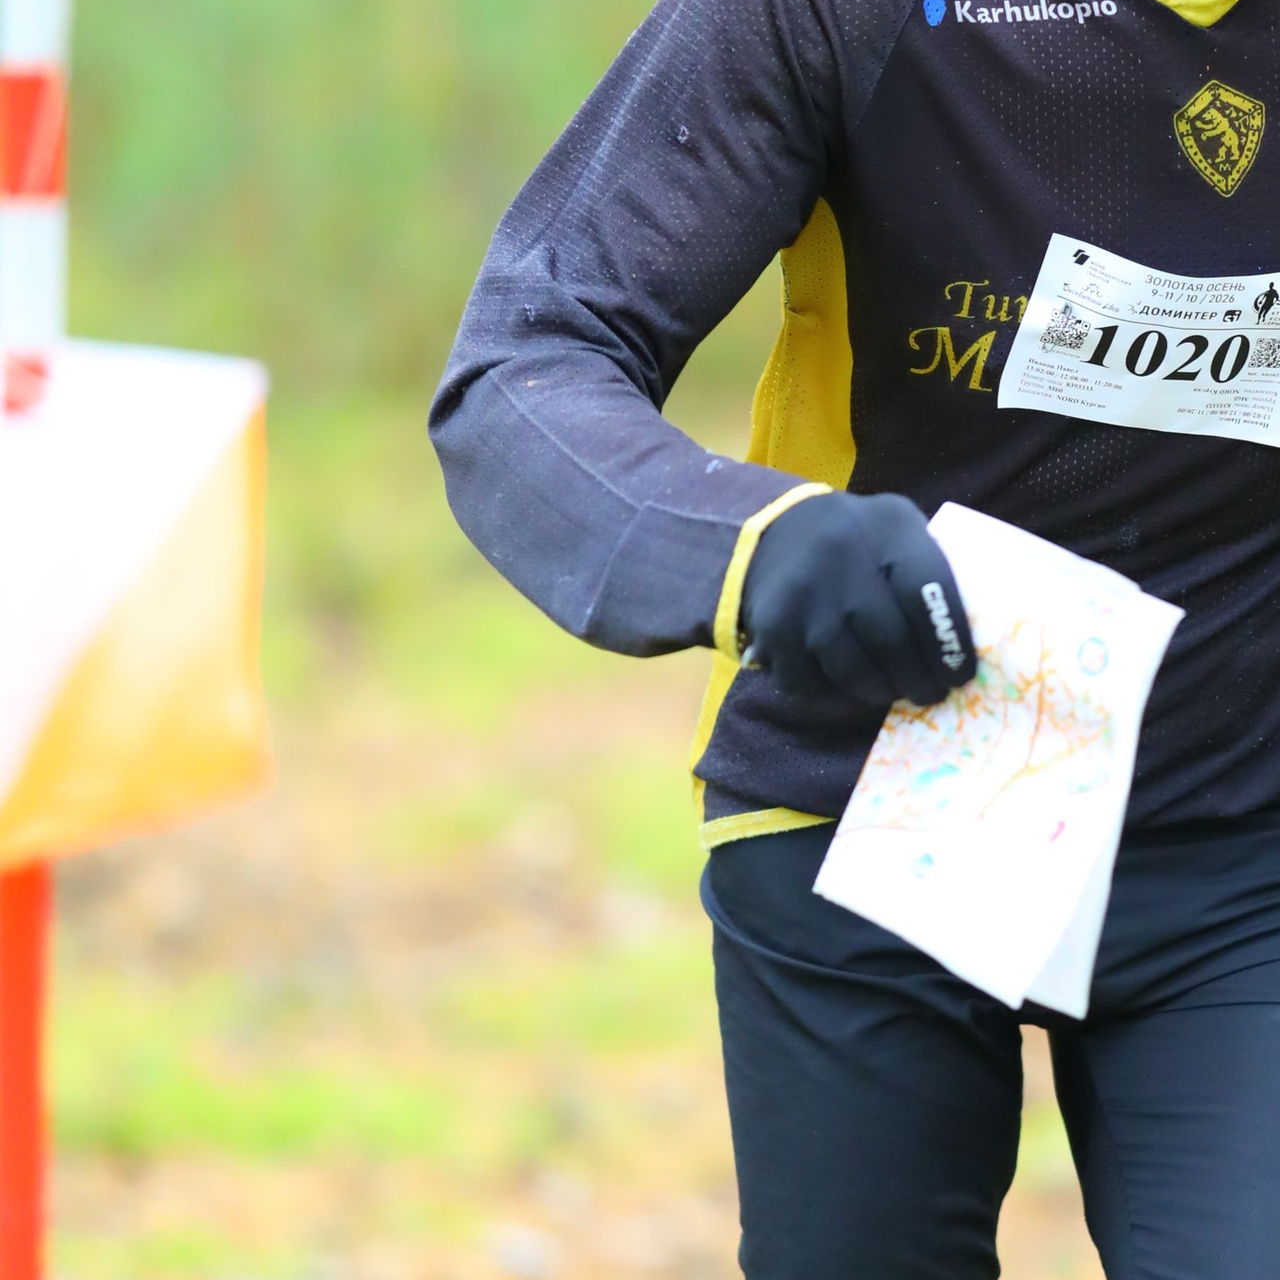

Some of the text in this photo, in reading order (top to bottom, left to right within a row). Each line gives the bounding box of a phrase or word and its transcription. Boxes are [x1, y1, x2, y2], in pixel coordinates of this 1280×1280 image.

[1145, 274, 1245, 292] ЗОЛОТАЯ ОСЕНЬ
[1186, 294, 1198, 303] 10
[1208, 294, 1235, 303] 2026
[1139, 305, 1218, 320] ДОМИНТЕР
[1079, 324, 1251, 384] 1020
[1056, 394, 1080, 404] NORD
[920, 581, 962, 653] CRAFT
